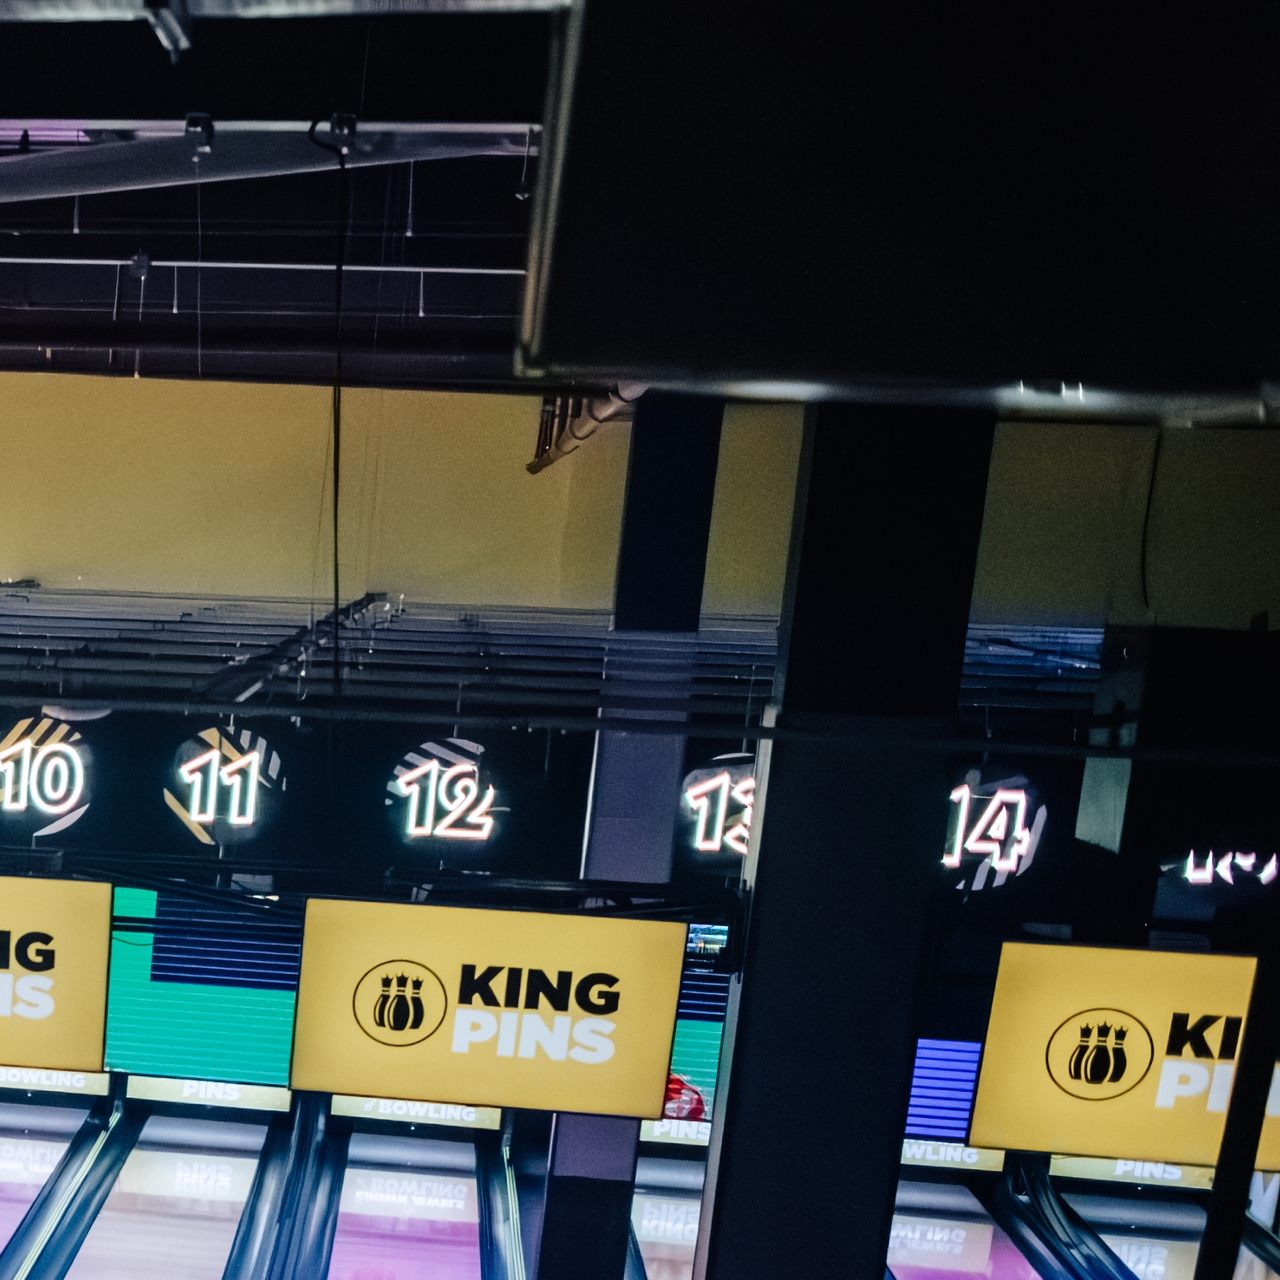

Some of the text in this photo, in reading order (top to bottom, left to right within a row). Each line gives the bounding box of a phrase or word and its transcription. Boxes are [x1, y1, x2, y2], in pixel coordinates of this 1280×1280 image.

[181, 750, 260, 824] 11
[398, 761, 495, 840] 12
[941, 784, 1030, 872] 14
[458, 963, 620, 1014] KING
[451, 1008, 618, 1065] PINS
[1165, 1012, 1243, 1060] KI
[182, 1080, 240, 1101] PINS
[1155, 1059, 1234, 1113] PI
[378, 1100, 476, 1122] BOWLING
[653, 1119, 711, 1140] PINS
[903, 1145, 979, 1164] WLING
[1115, 1159, 1183, 1181] PINS
